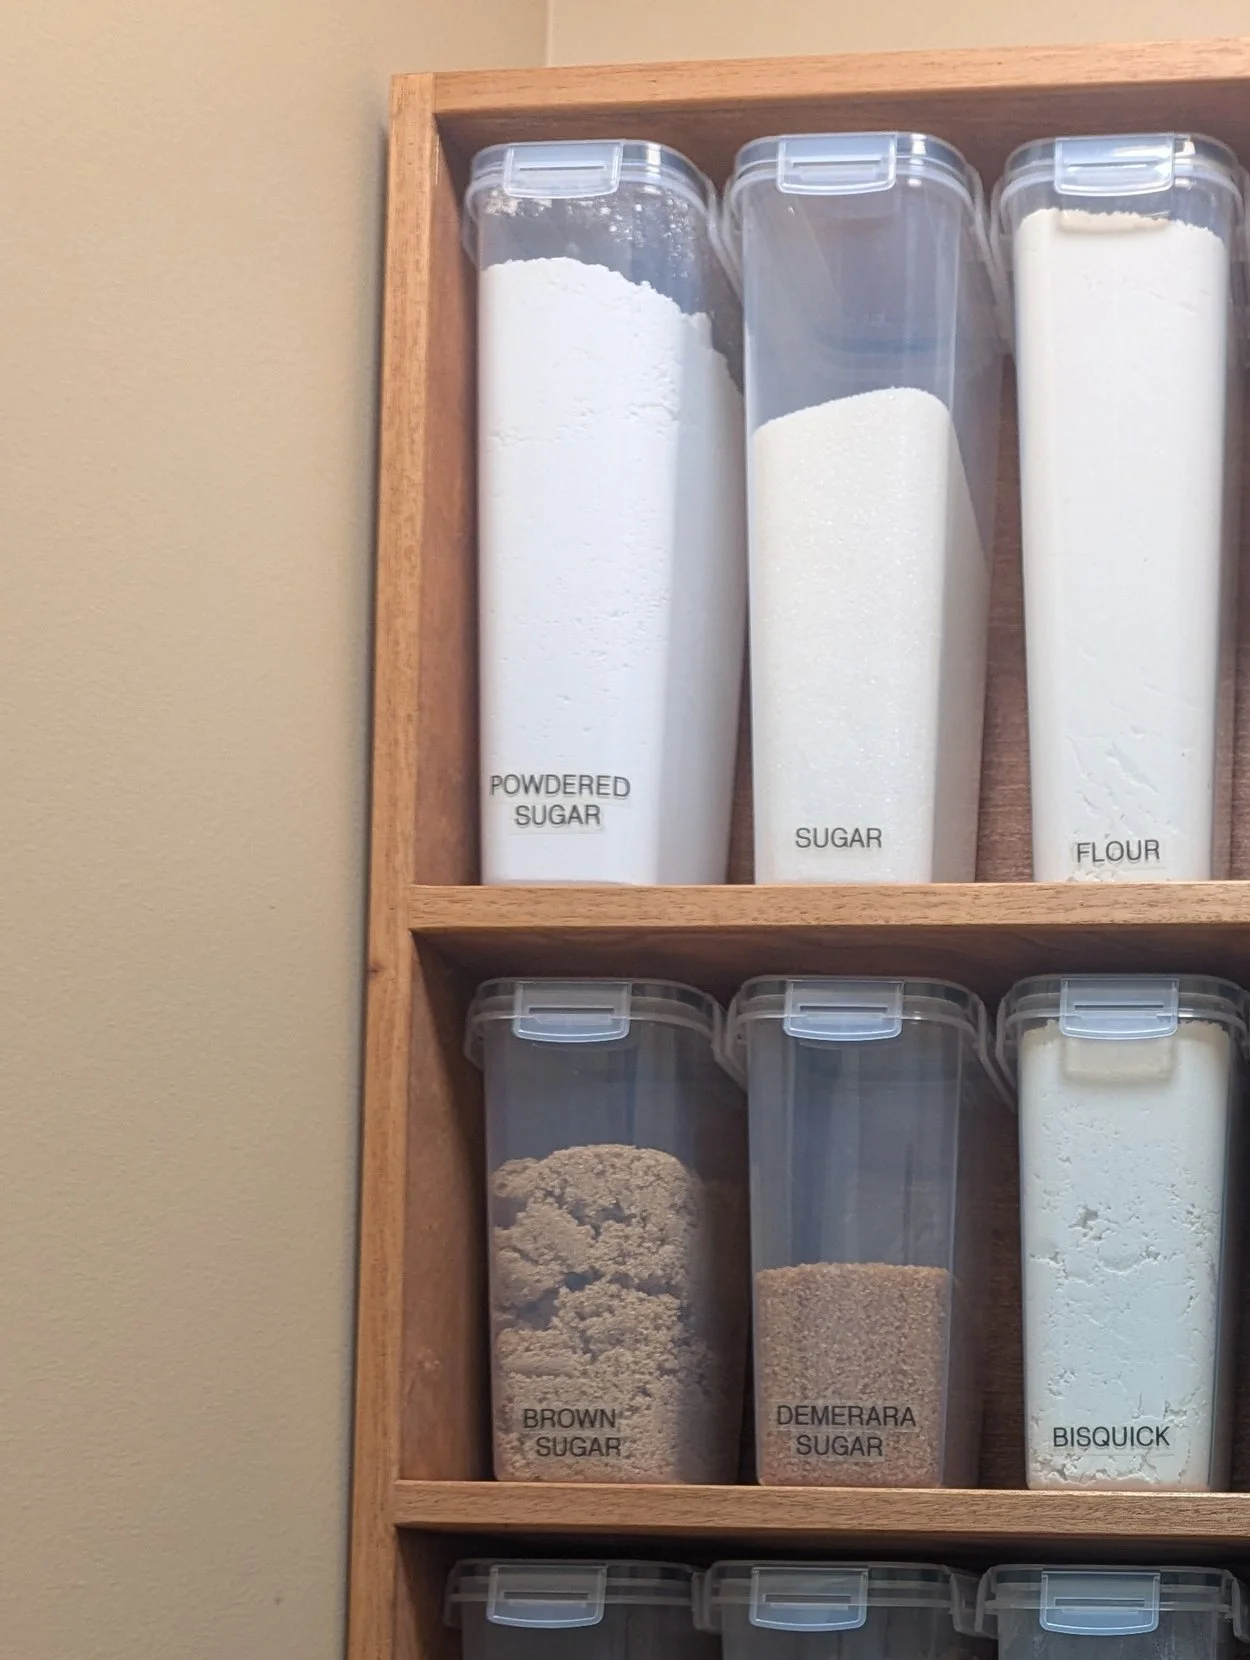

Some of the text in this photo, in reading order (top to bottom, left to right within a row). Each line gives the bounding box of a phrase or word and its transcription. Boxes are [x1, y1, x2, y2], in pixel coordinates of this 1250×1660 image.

[490, 774, 631, 799] POWDERED
[513, 804, 602, 827] SUGAR
[794, 827, 883, 850] SUGAR
[1075, 839, 1160, 863] FLOUR
[523, 1408, 616, 1430] BROWN
[776, 1404, 917, 1427] DEMERARA
[535, 1436, 622, 1458] SUGAR
[795, 1433, 884, 1457] SUGAR
[1052, 1425, 1171, 1449] BISQUICK
